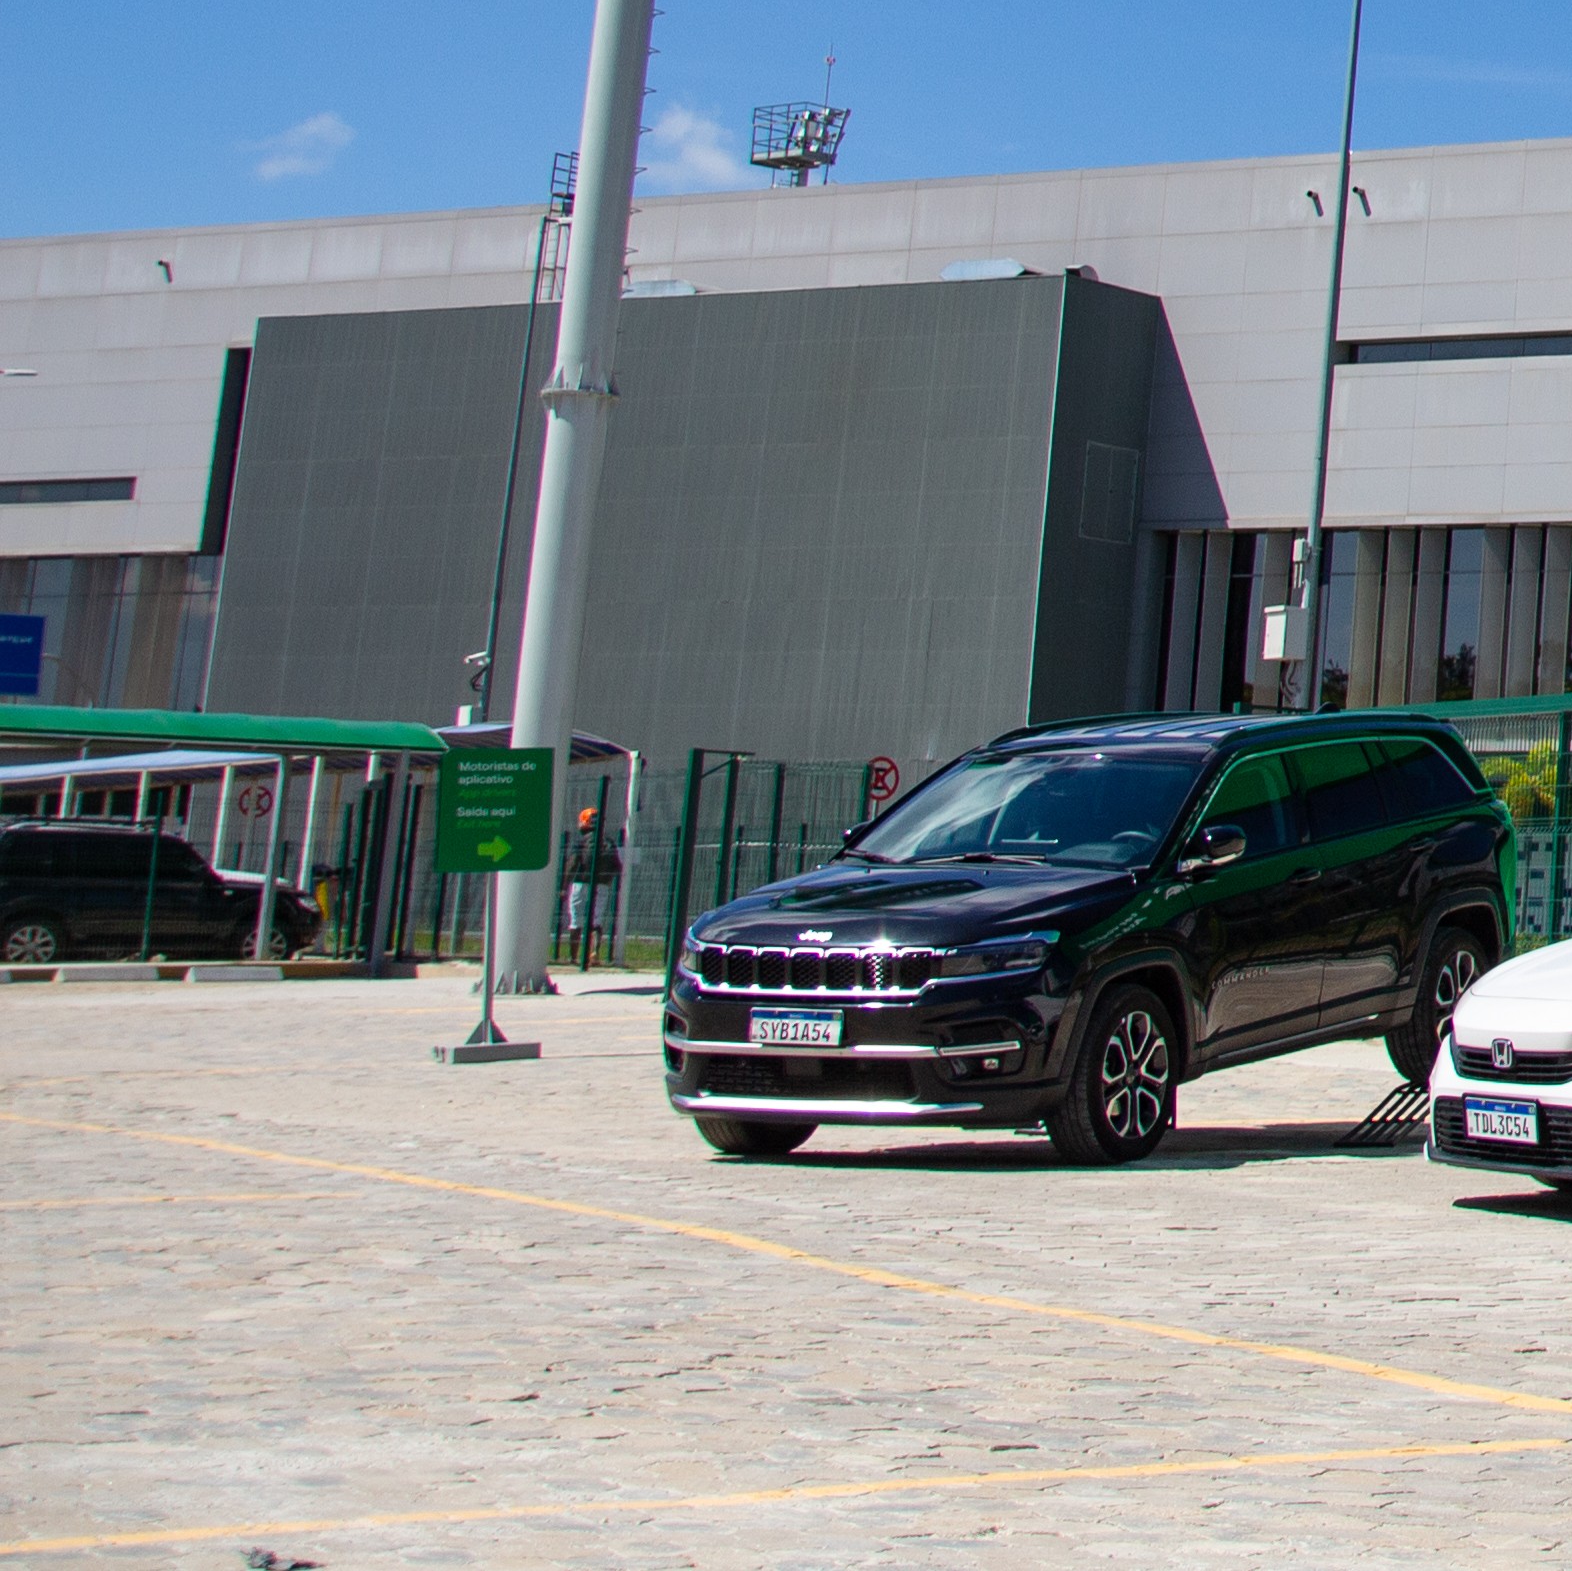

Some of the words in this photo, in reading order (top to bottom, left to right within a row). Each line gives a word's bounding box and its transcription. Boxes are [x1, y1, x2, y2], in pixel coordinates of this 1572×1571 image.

[458, 761, 519, 771] Motoristas
[521, 760, 537, 771] de
[458, 774, 514, 786] aplicativo
[760, 1020, 831, 1042] SYB1A54
[1473, 1112, 1530, 1138] TDL3C54
